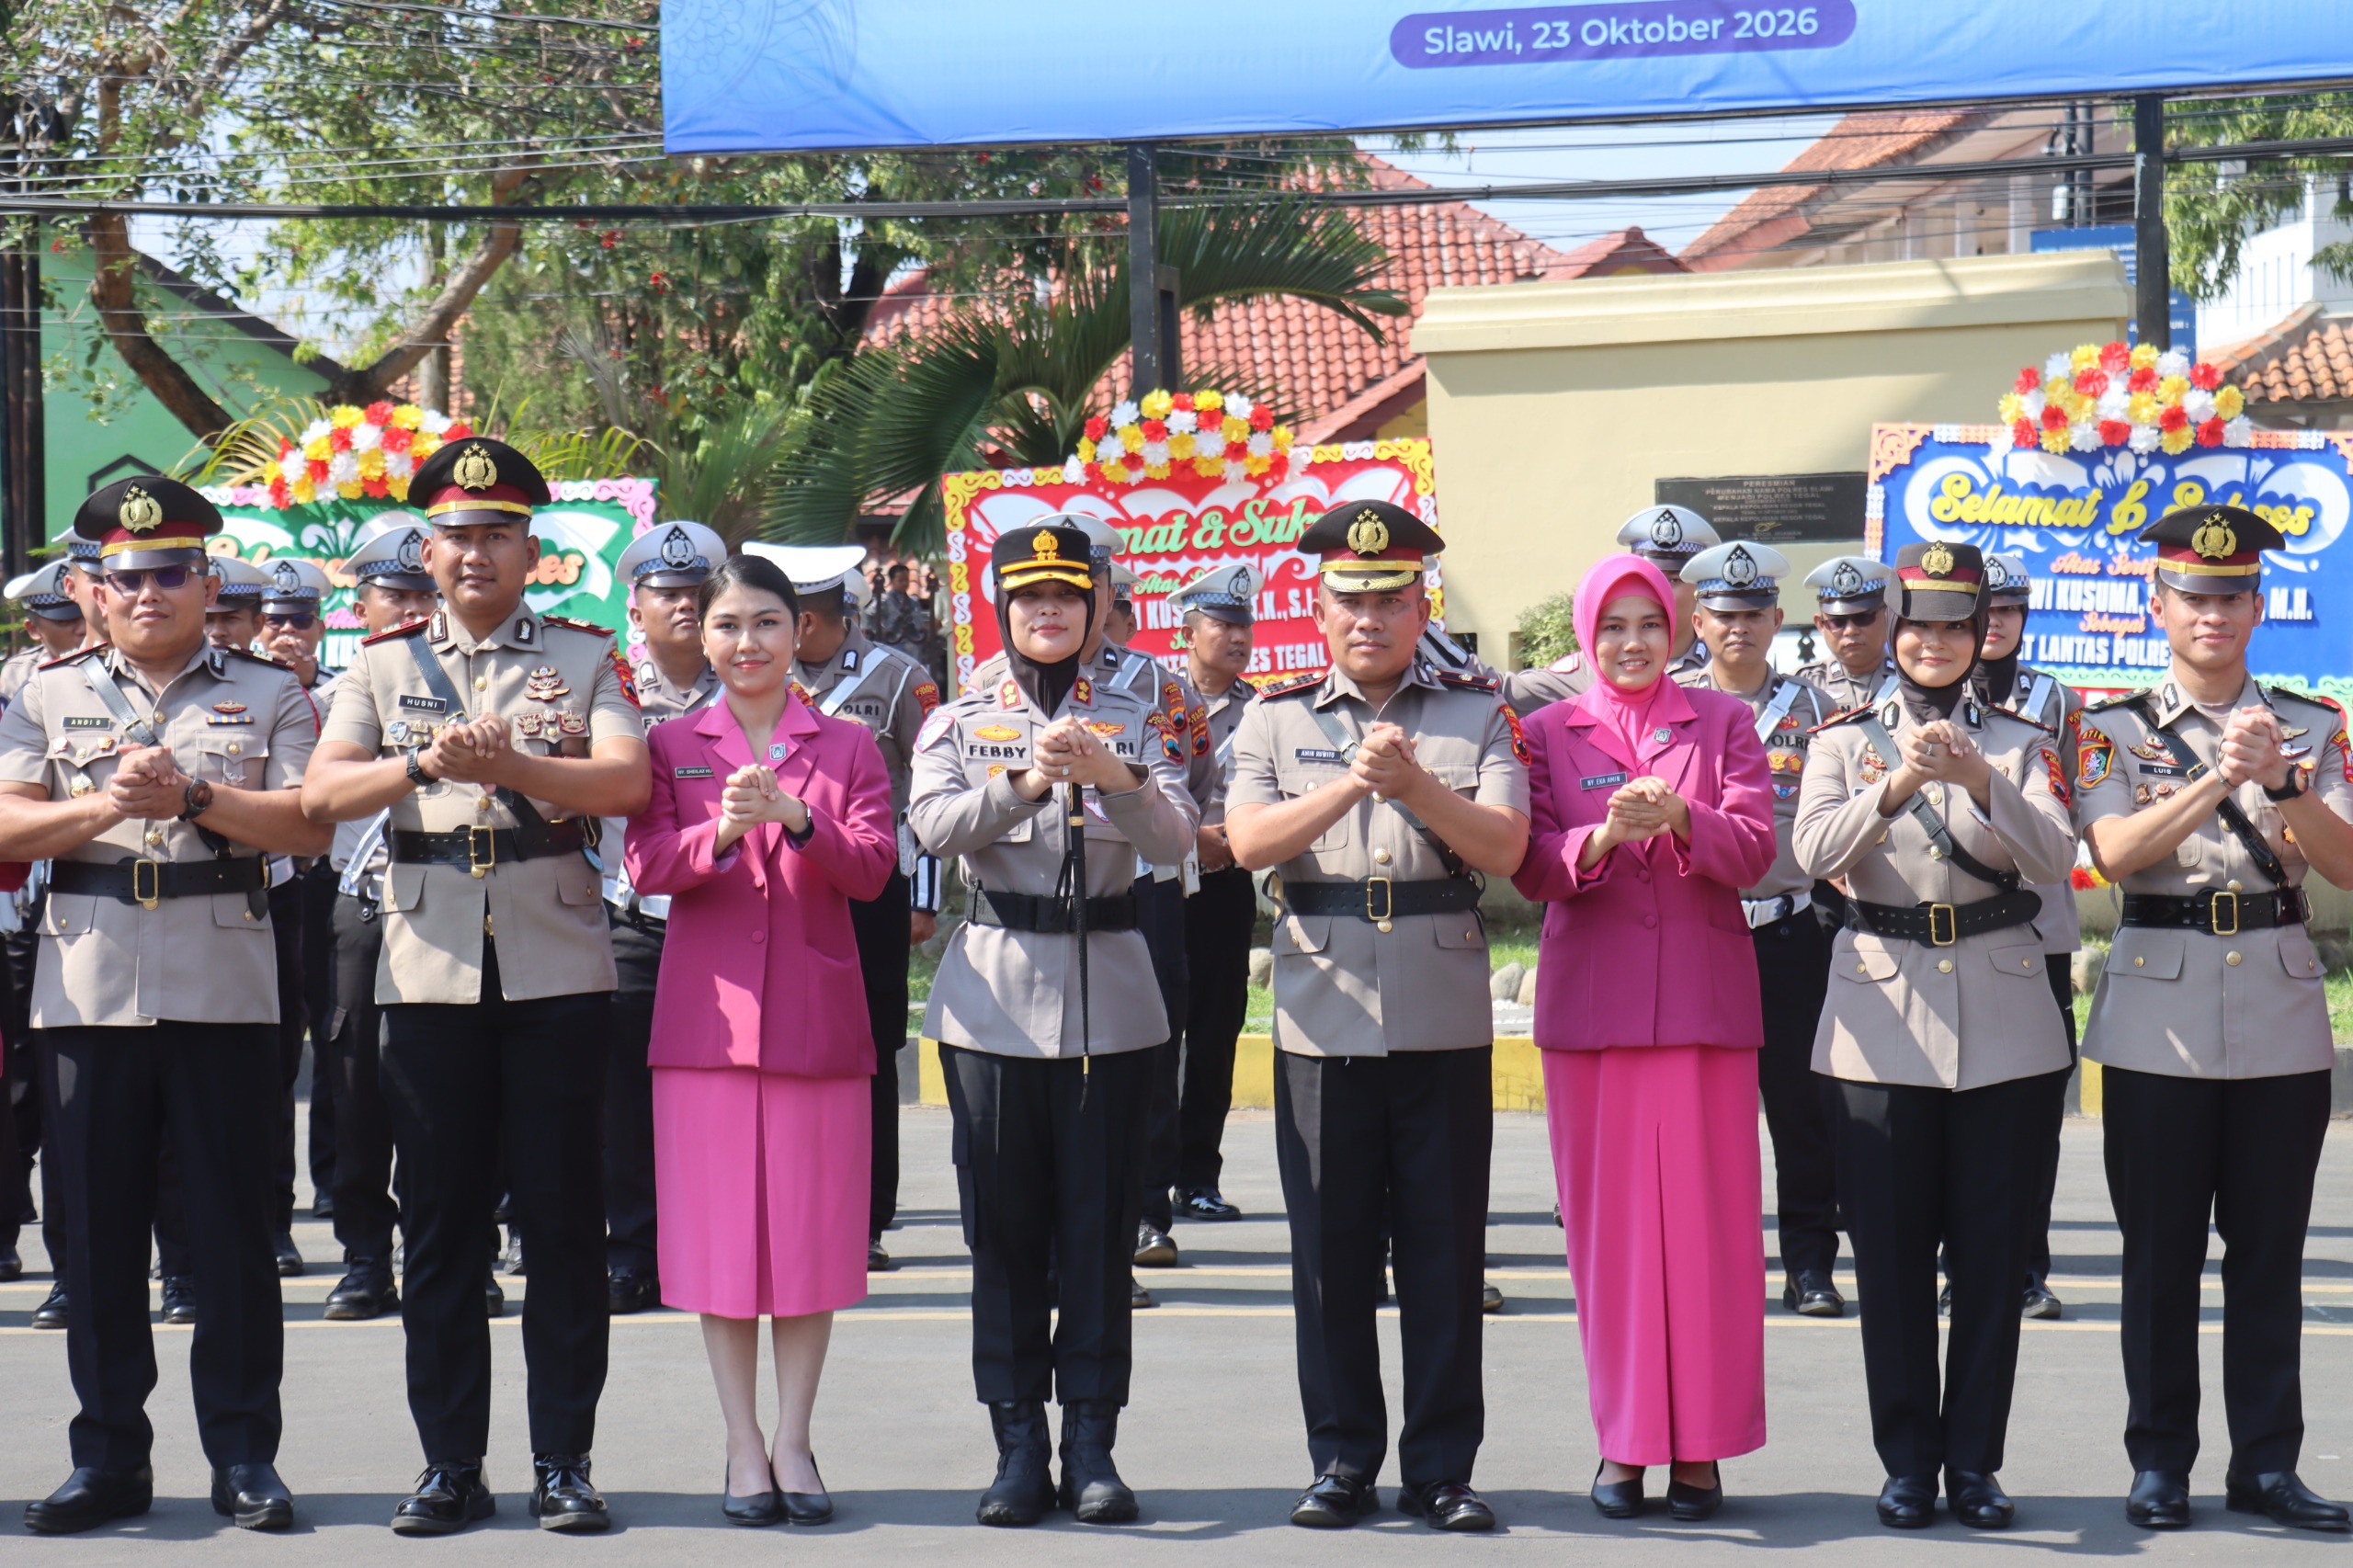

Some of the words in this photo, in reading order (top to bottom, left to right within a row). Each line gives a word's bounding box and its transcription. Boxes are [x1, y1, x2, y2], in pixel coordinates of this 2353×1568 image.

[1424, 23, 1522, 55] Slawi,
[1531, 22, 1571, 49] 23
[1580, 15, 1724, 47] Oktober
[1733, 7, 1819, 39] 2026
[1931, 473, 2103, 528] Selamat
[1192, 511, 1226, 549] &
[2056, 580, 2145, 615] KUSUMA,
[2269, 586, 2313, 620] M.H.
[2079, 610, 2146, 638] Sebagai
[1274, 642, 1327, 671] TEGAL
[2039, 635, 2108, 664] LANTAS
[407, 699, 438, 709] HUSNI
[844, 705, 879, 716] OLRI
[2082, 730, 2105, 742] STIK
[969, 744, 1026, 759] FEBBY
